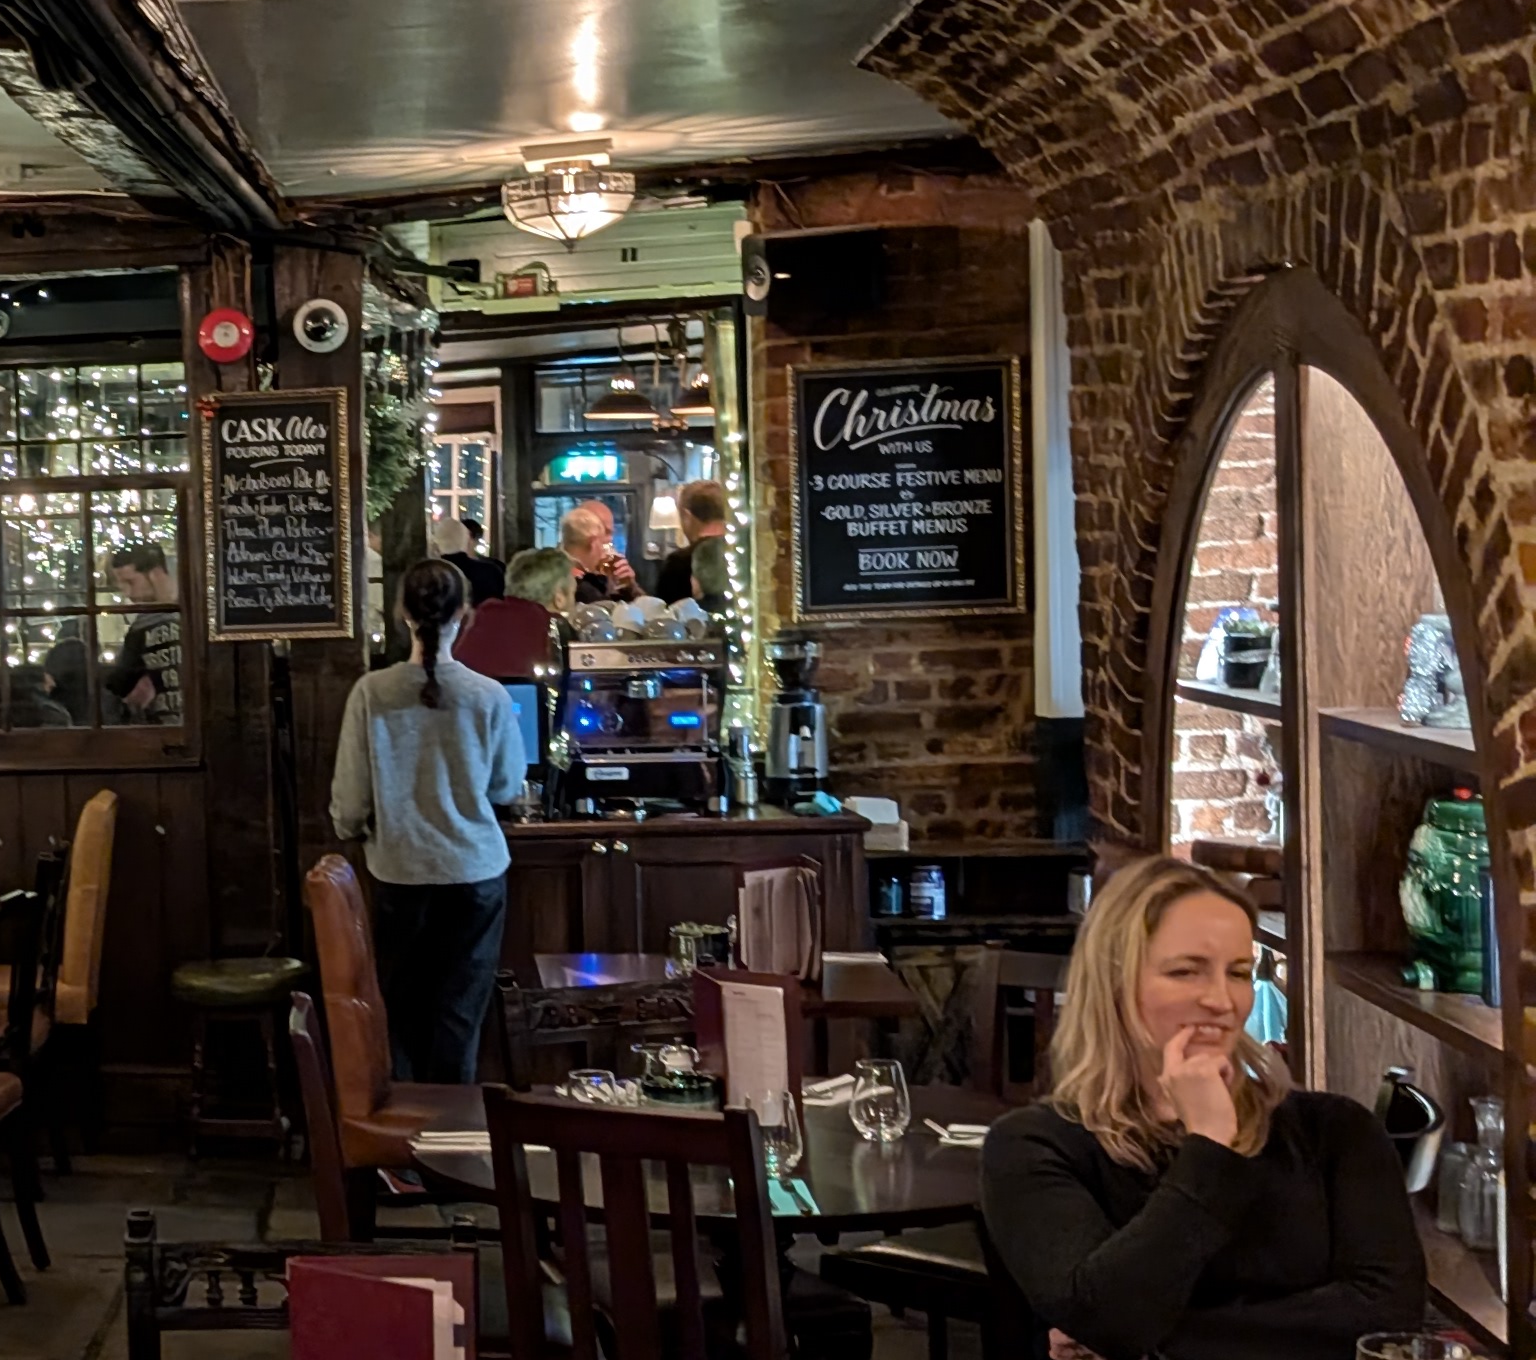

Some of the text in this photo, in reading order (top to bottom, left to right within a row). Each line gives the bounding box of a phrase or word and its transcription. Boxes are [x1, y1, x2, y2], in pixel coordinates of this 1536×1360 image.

[814, 383, 997, 451] Christmas
[221, 415, 329, 443] CASK Ales
[225, 445, 280, 459] POURING
[878, 440, 934, 455] WITH US
[826, 472, 891, 490] COURSE
[896, 469, 963, 487] FESTIVE
[964, 468, 1003, 485] MENU
[847, 518, 969, 537] BUFFET MENUS
[858, 549, 959, 571] BOOK NOW
